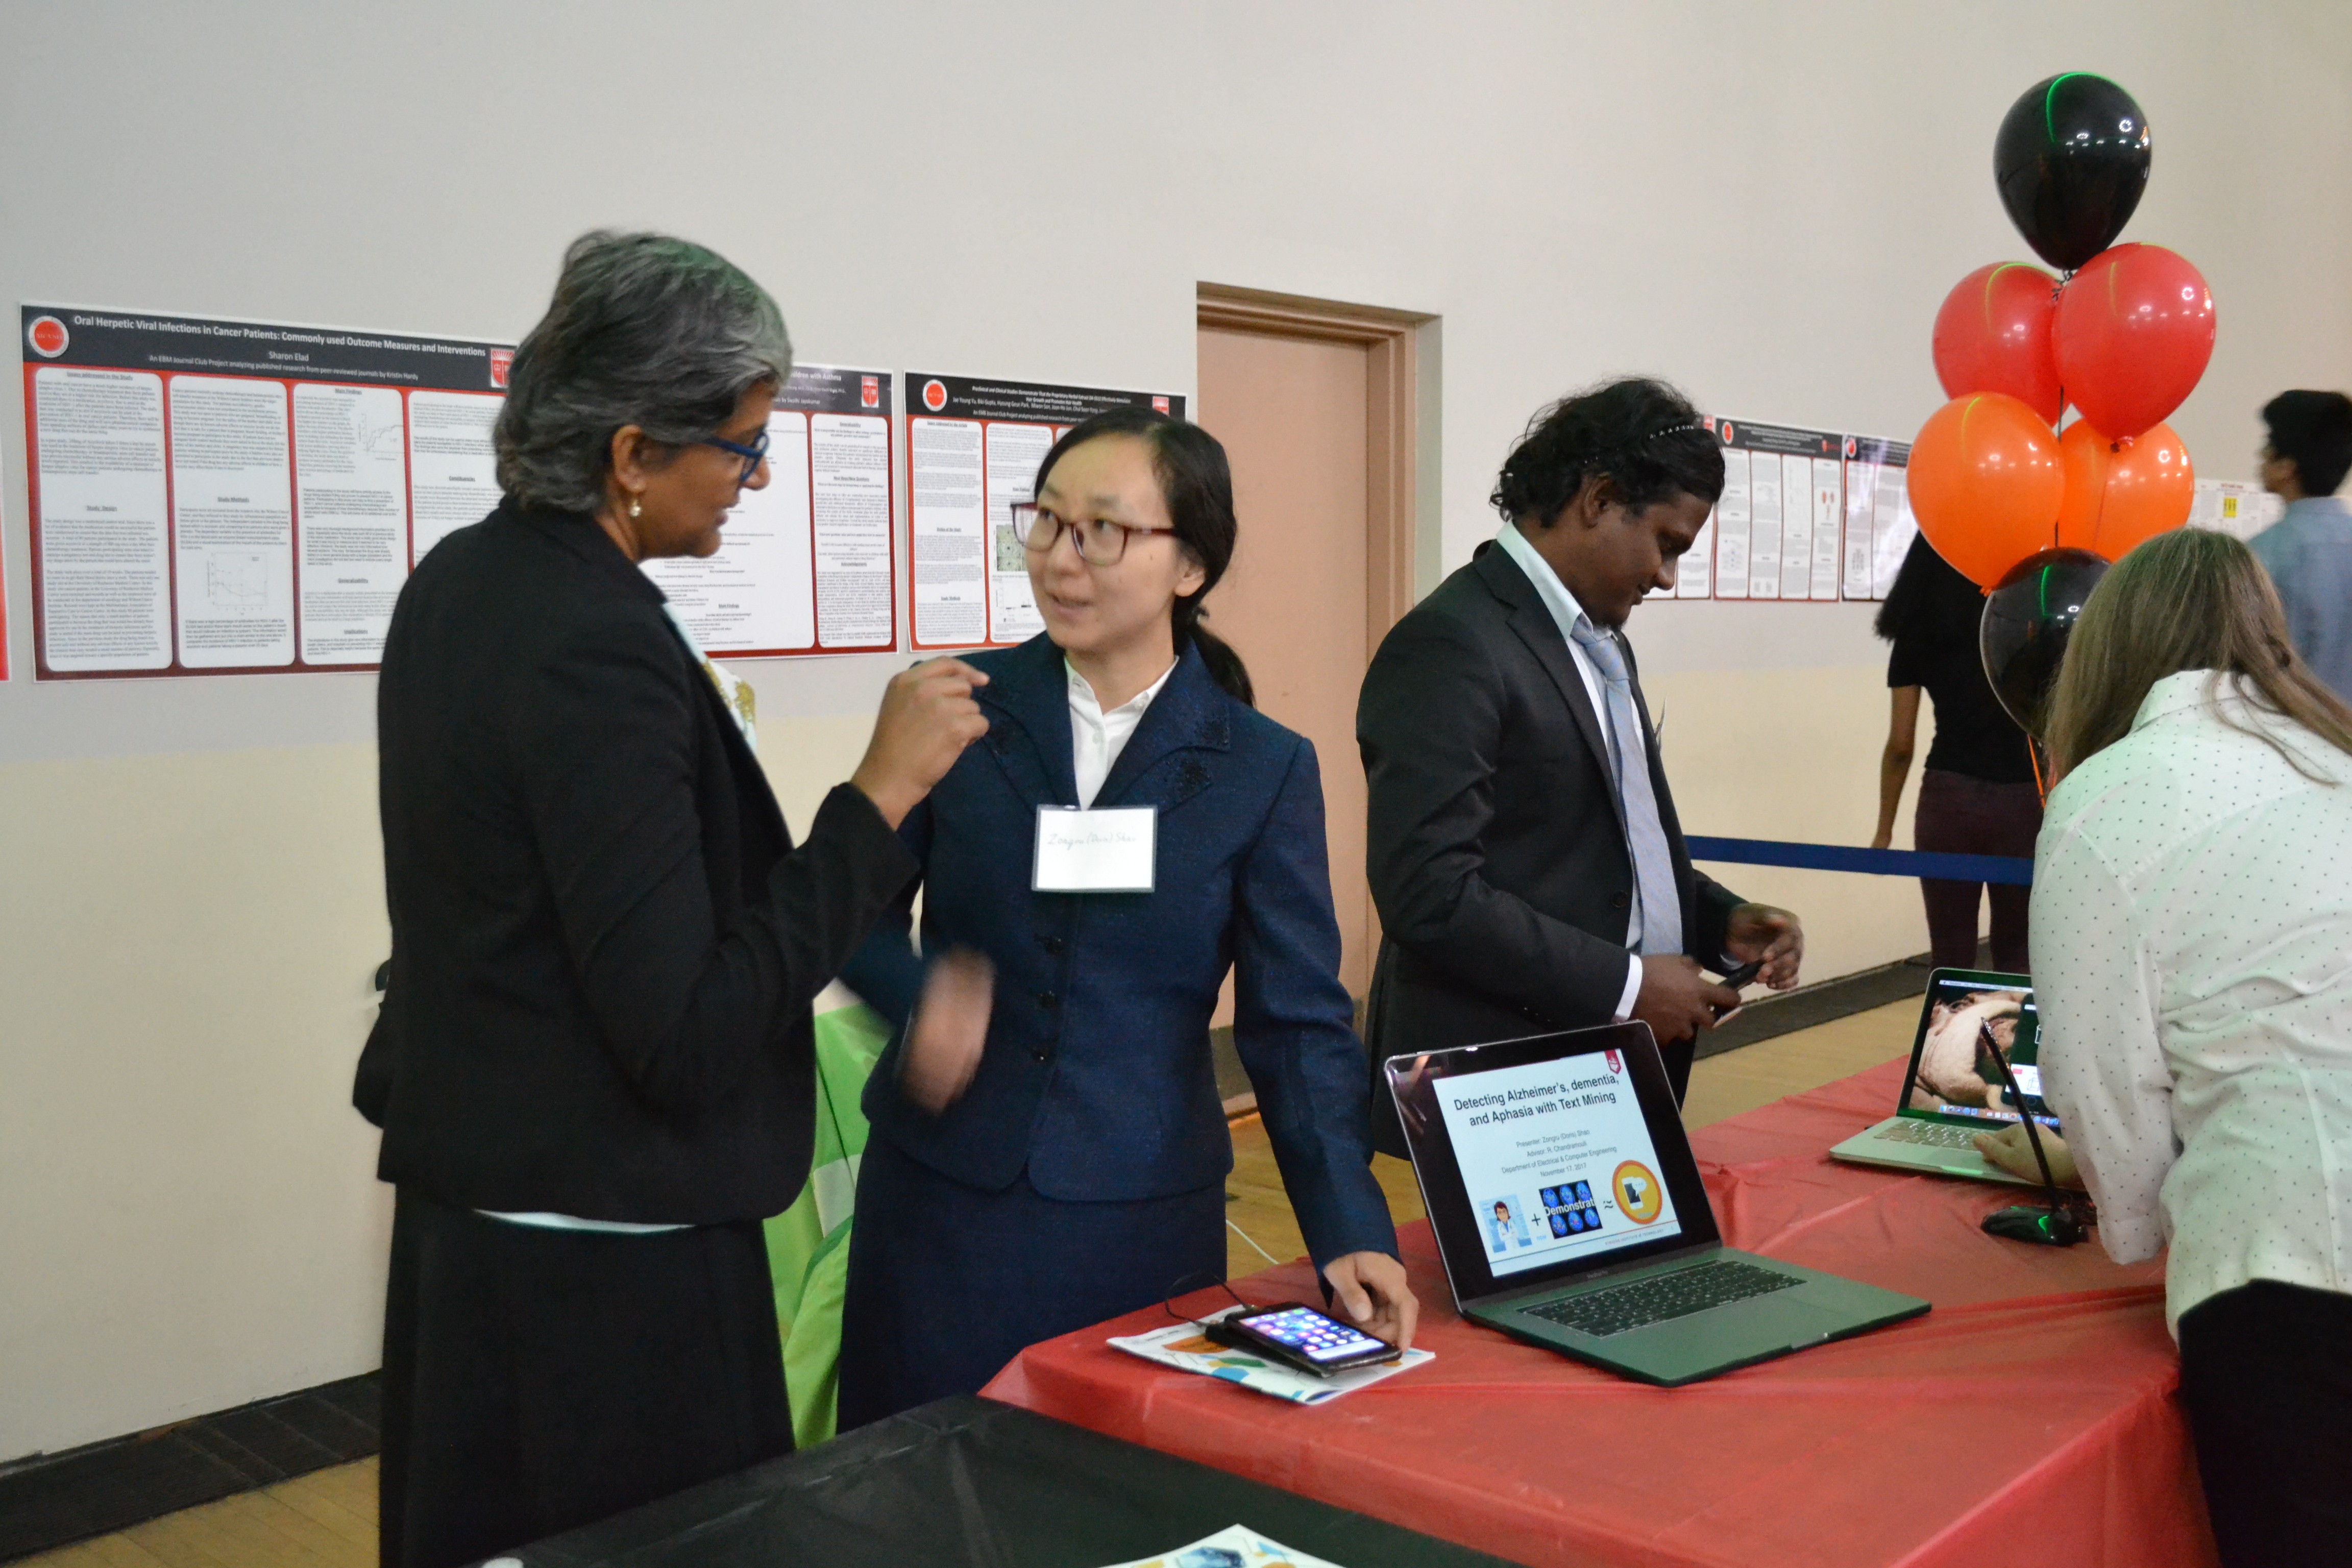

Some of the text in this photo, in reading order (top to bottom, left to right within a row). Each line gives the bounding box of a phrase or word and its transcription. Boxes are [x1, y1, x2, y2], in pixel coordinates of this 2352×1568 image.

[75, 315, 485, 356] Oral Herpetic Viral Infections in Cancer Patients: Commonly used Outcome Measures and Interventions
[268, 351, 309, 361] Sharon Elad
[209, 359, 228, 368] Project
[230, 361, 255, 370] analyzing
[256, 362, 281, 371] published
[321, 367, 357, 376] peer-reviewed
[358, 369, 378, 378] journals
[379, 371, 386, 379] by
[386, 371, 403, 379] Kristin
[404, 373, 419, 381] Hardy
[1454, 1074, 1619, 1111] Detecting Alzheimer's, dementia,
[1469, 1092, 1616, 1126] and Aphasia with Text Mining
[1516, 1139, 1541, 1148] Presenter:
[1542, 1135, 1559, 1144] Zongru
[1502, 1163, 1533, 1174] Department
[1537, 1157, 1559, 1167] Electrical
[1564, 1152, 1588, 1162] Computer
[1589, 1146, 1617, 1157] Engineering
[1527, 1149, 1546, 1157] Advisor:
[1540, 1167, 1565, 1177] November
